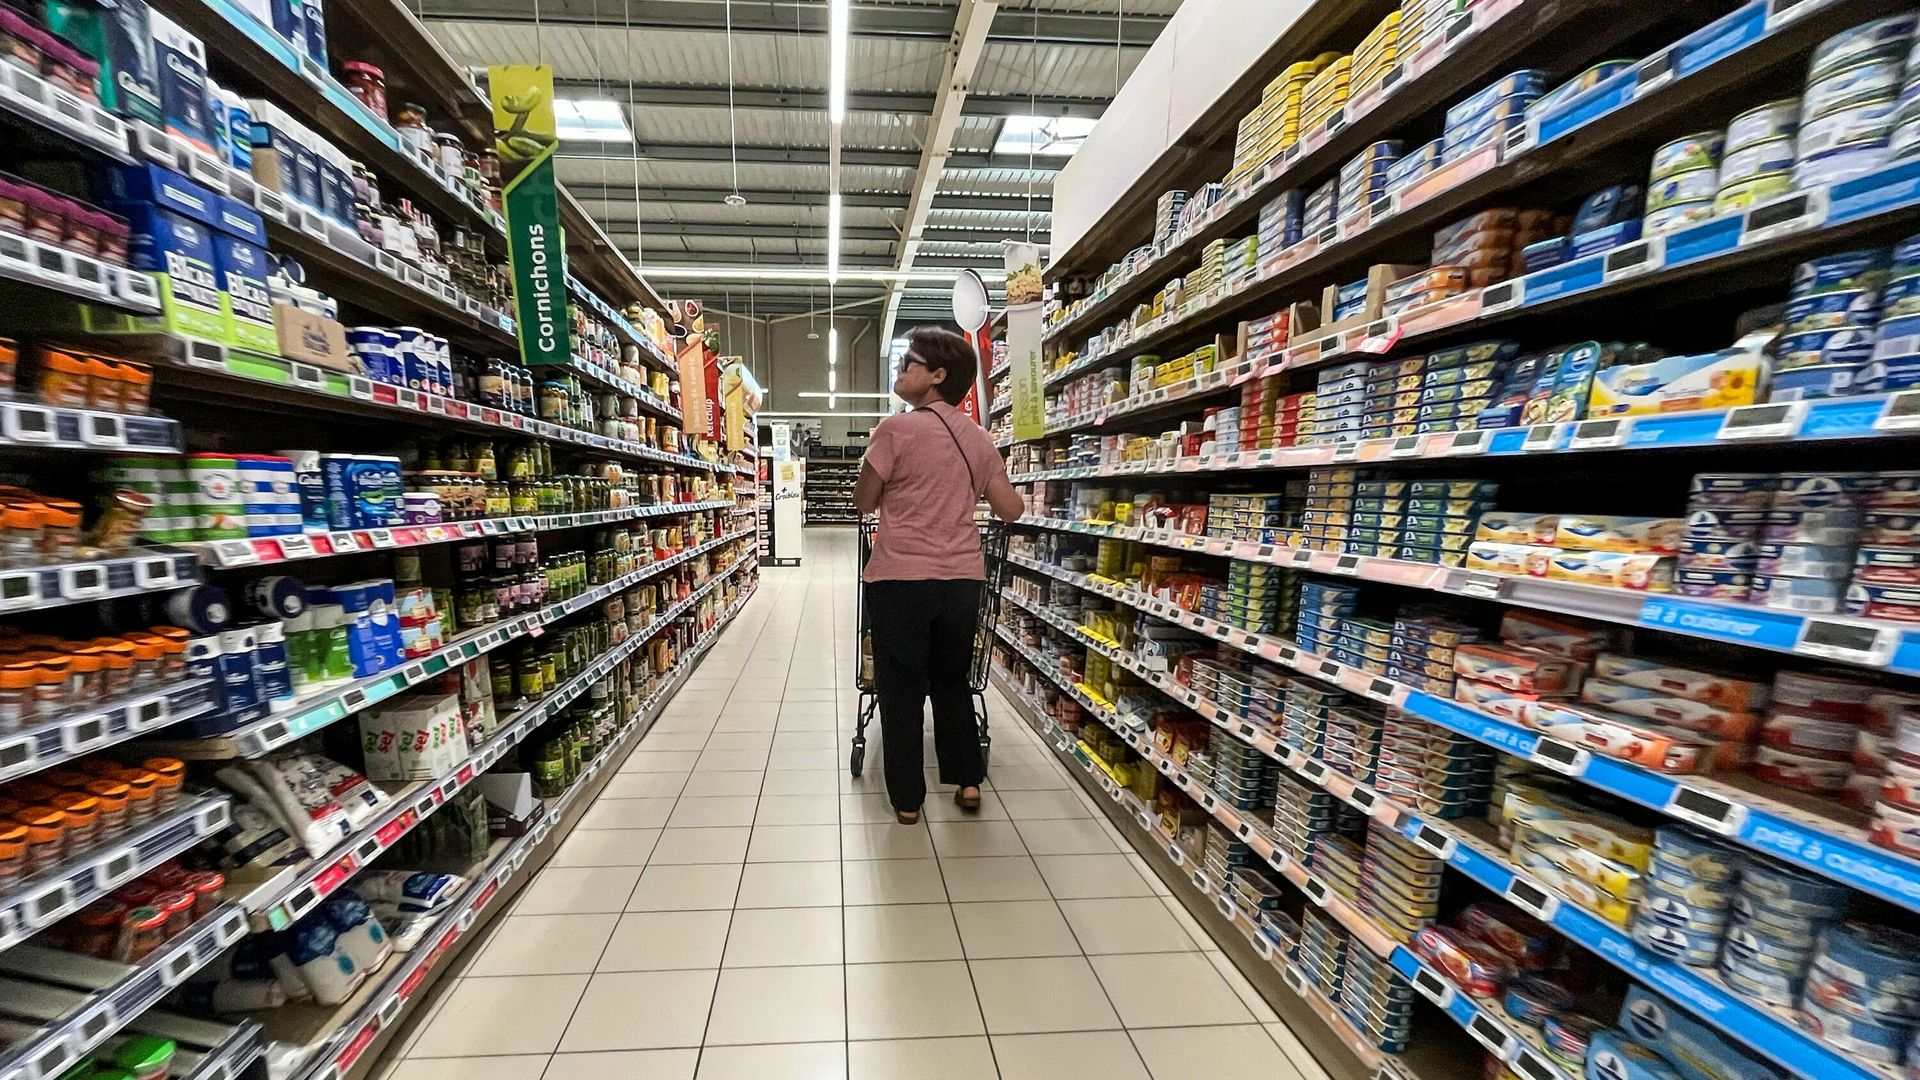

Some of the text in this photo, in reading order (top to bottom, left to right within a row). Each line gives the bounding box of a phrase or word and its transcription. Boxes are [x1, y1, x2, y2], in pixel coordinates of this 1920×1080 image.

[528, 223, 556, 353] Cornichons
[1018, 377, 1029, 426] Poisson
[1030, 350, 1040, 424] prêt à savourer
